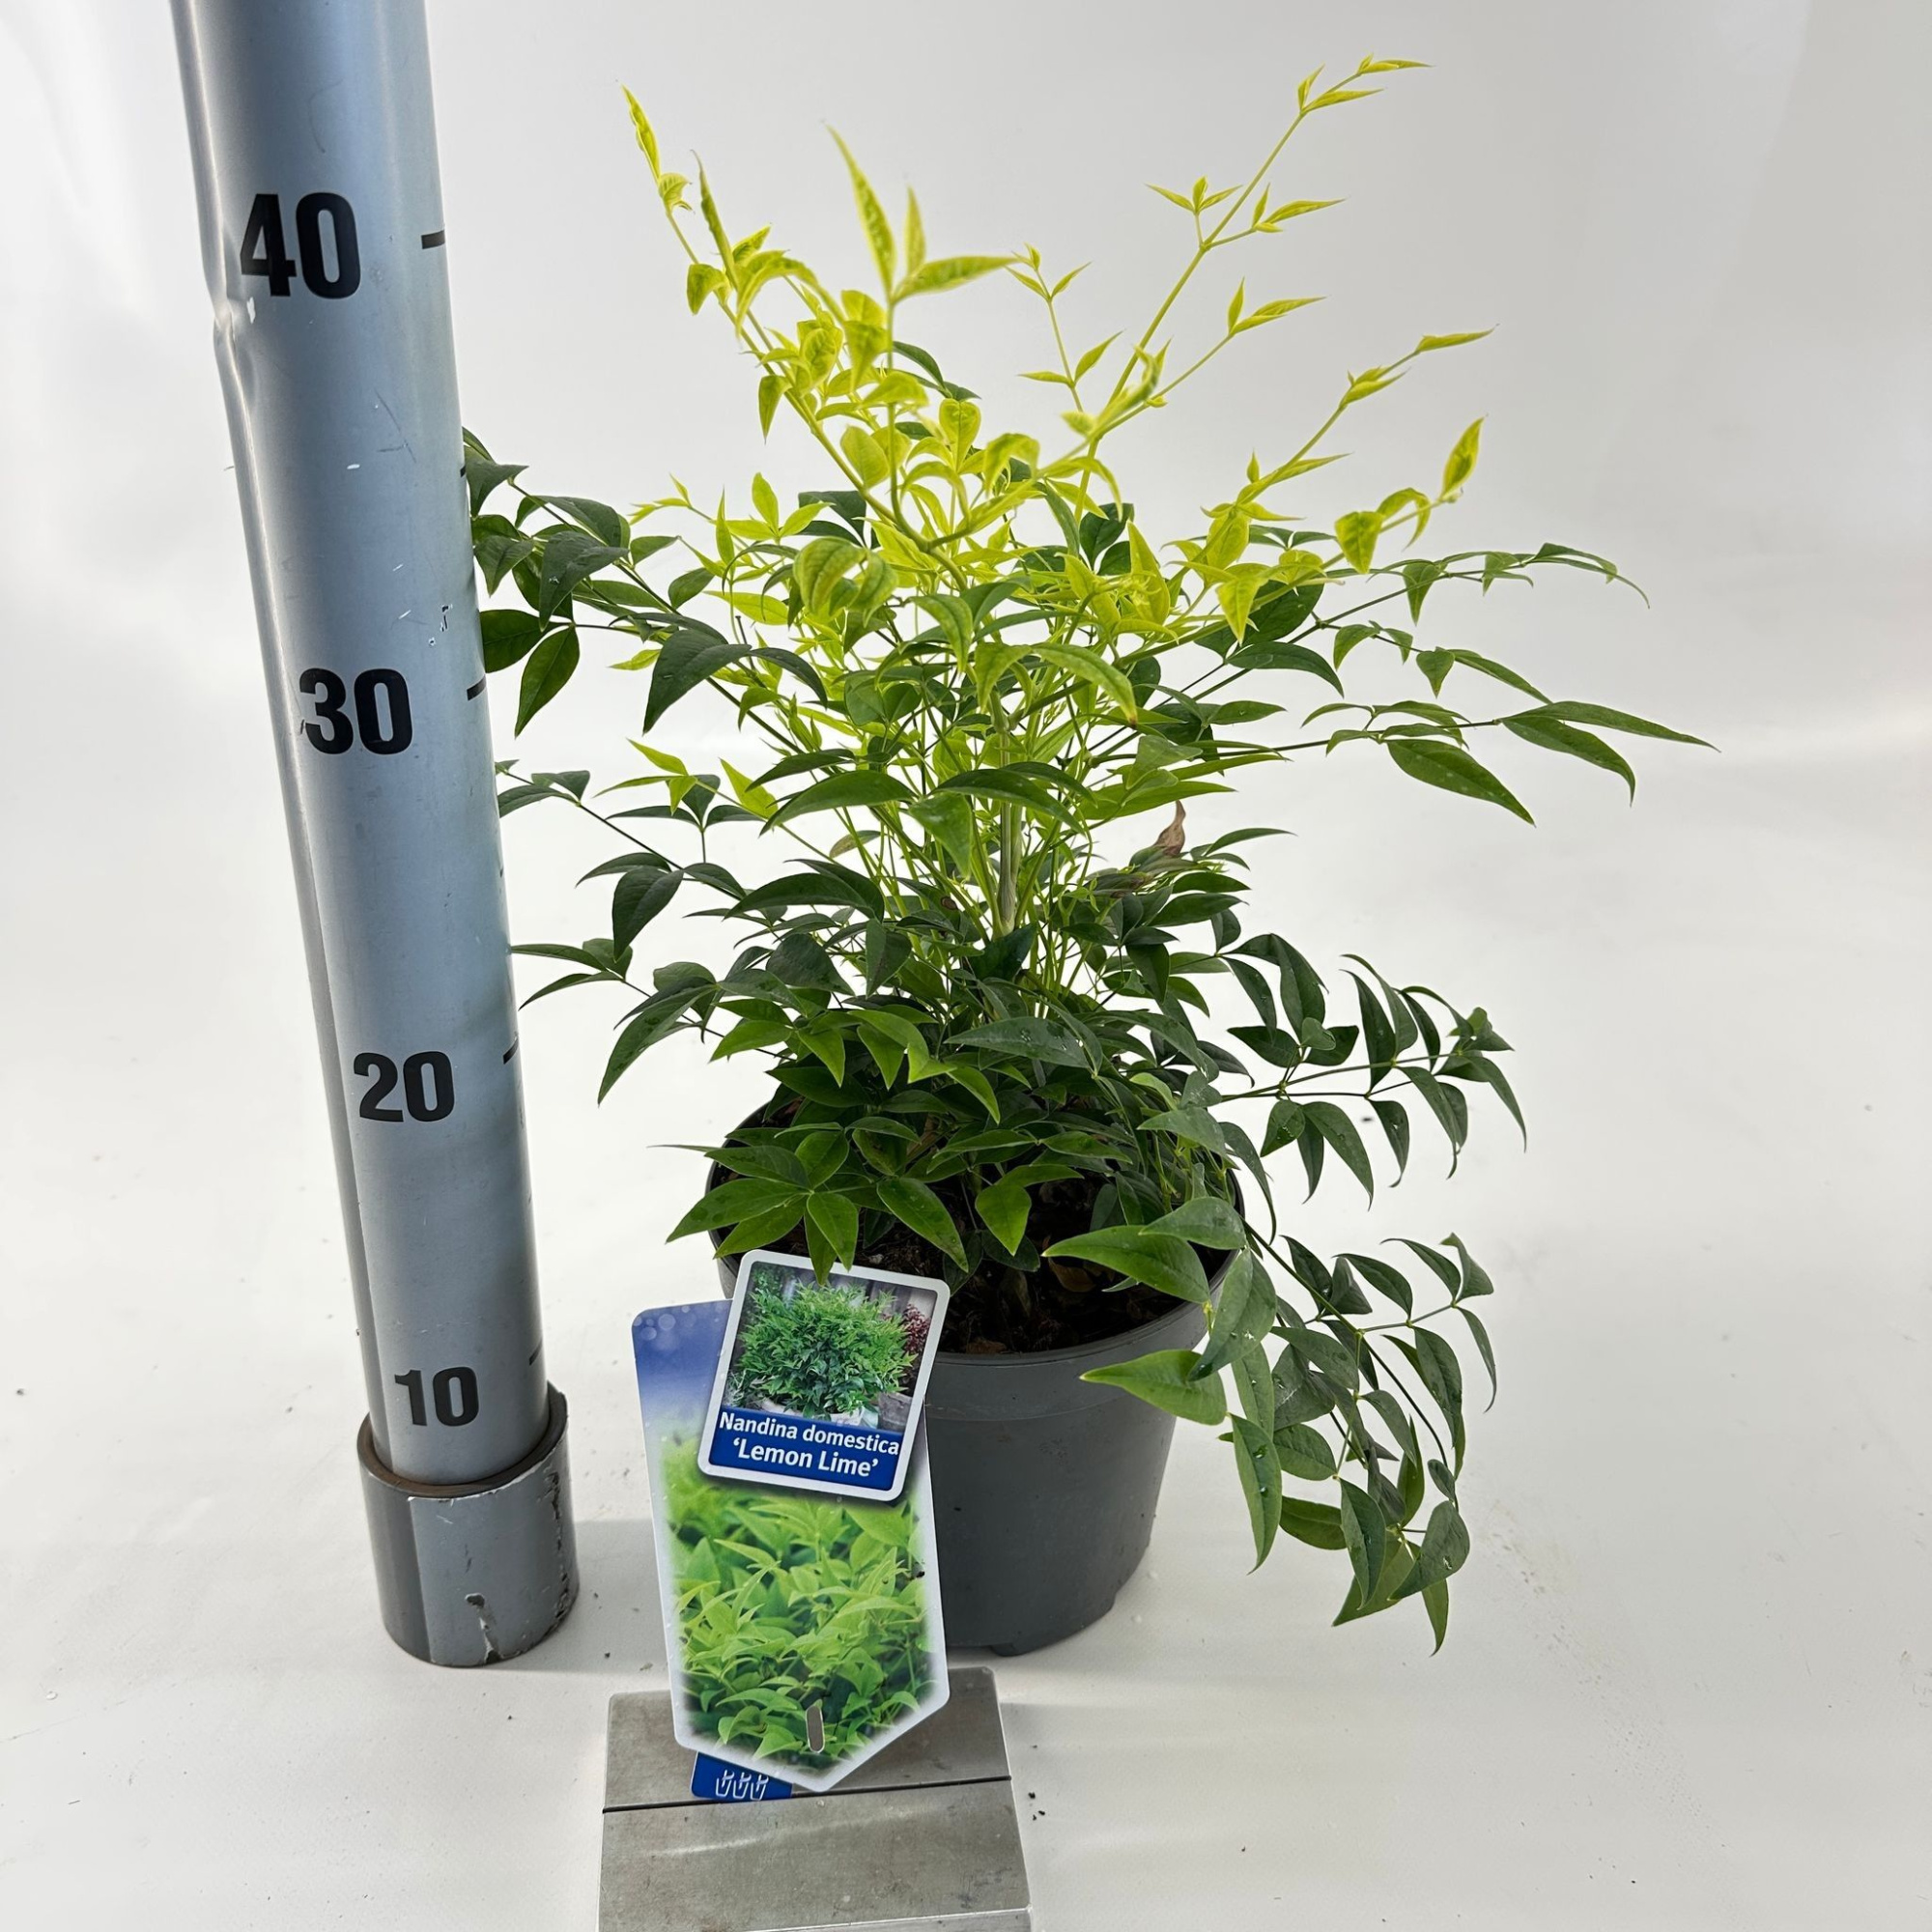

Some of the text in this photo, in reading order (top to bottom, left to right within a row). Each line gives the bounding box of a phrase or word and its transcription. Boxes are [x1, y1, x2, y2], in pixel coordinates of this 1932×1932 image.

[240, 192, 361, 299] 40
[299, 668, 413, 755] 30
[353, 1051, 455, 1122] 20
[394, 1366, 479, 1427] 10
[719, 1411, 899, 1455] Nandina domestica
